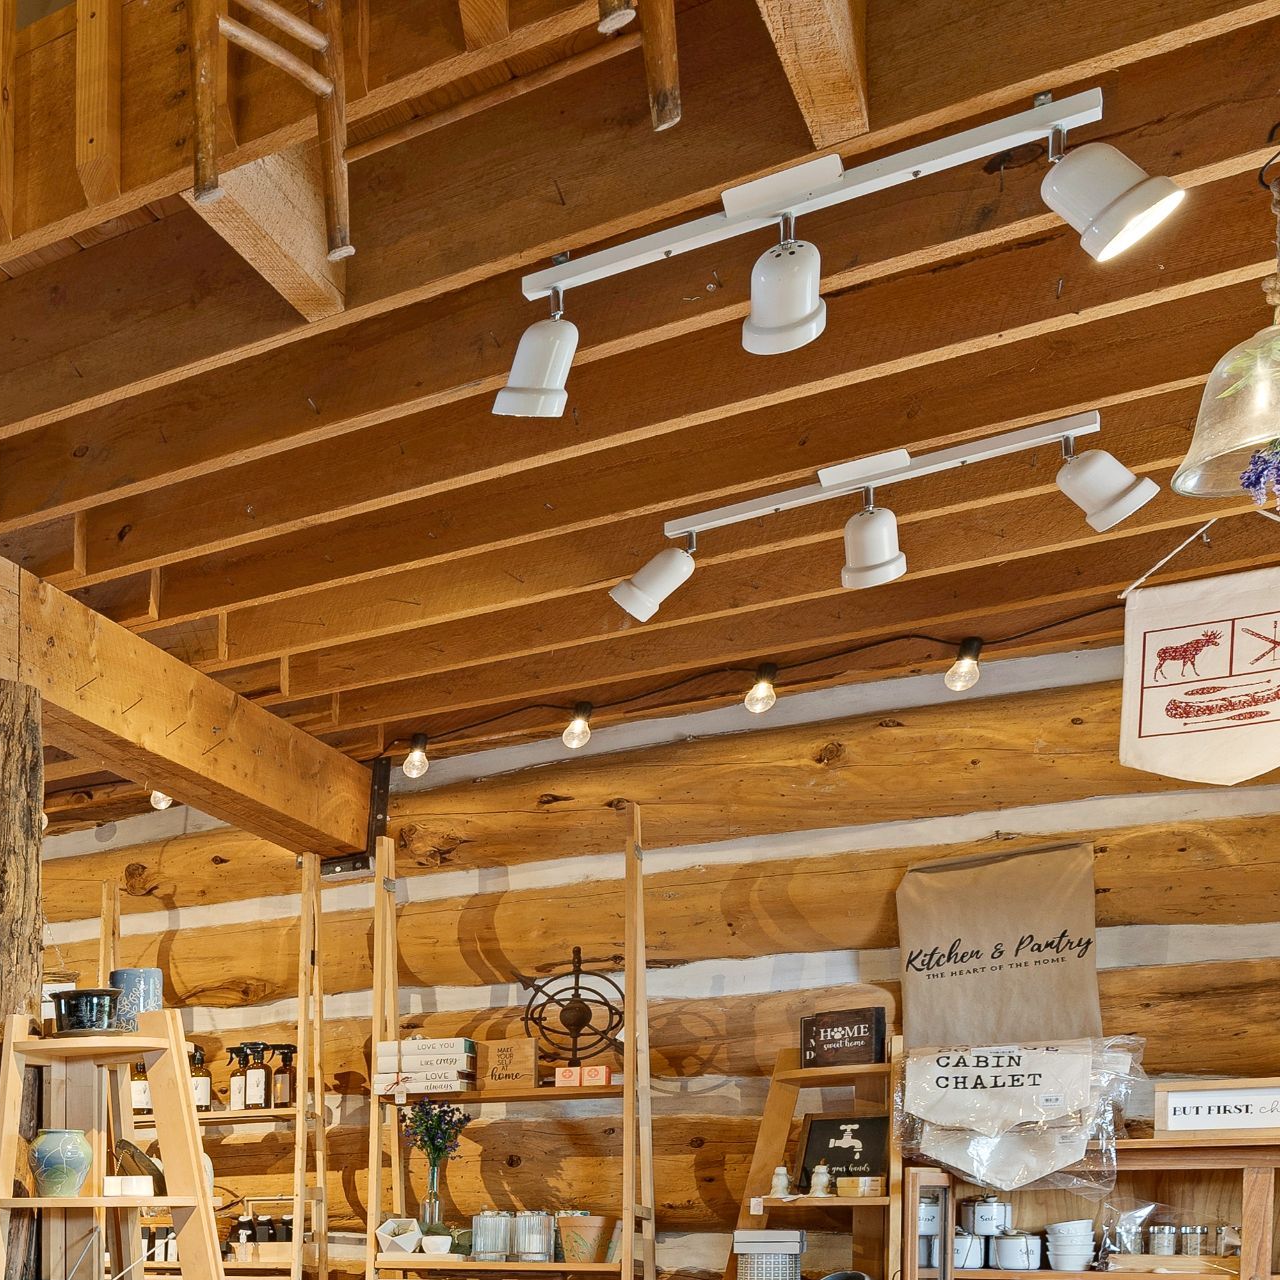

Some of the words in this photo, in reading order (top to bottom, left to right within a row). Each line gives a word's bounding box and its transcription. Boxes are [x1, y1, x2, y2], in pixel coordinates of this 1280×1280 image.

[905, 937, 984, 973] Kitchen
[990, 942, 1006, 960] &
[1014, 929, 1094, 959] Pantry
[950, 966, 987, 977] HEART
[990, 964, 1005, 972] OF
[1008, 961, 1030, 969] THE
[1034, 956, 1067, 966] HOME
[417, 1043, 436, 1051] LOVE
[823, 1041, 843, 1050] sweet
[844, 1038, 866, 1047] home
[935, 1055, 1022, 1068] CABIN
[425, 1072, 449, 1080] LOVE
[490, 1066, 521, 1081] home
[424, 1082, 453, 1090] always
[935, 1073, 1042, 1089] CHALET
[1173, 1105, 1203, 1116] BUT
[832, 1165, 846, 1173] your
[849, 1163, 870, 1172] hands
